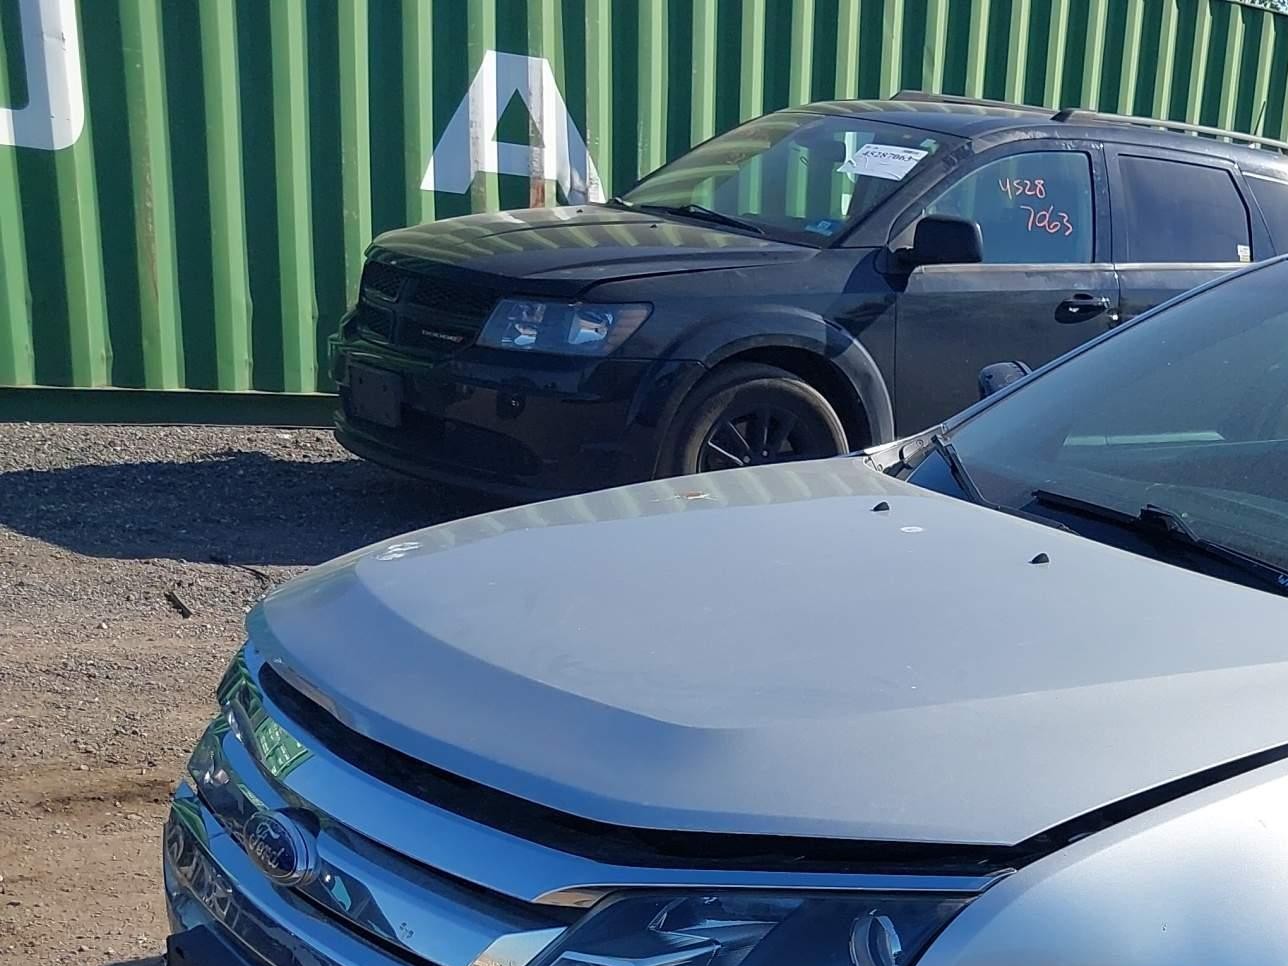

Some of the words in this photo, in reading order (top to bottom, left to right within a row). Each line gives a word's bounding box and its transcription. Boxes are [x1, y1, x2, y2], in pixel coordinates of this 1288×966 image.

[998, 177, 1046, 200] 4528
[1019, 205, 1073, 236] 7063
[249, 822, 285, 869] Ford
